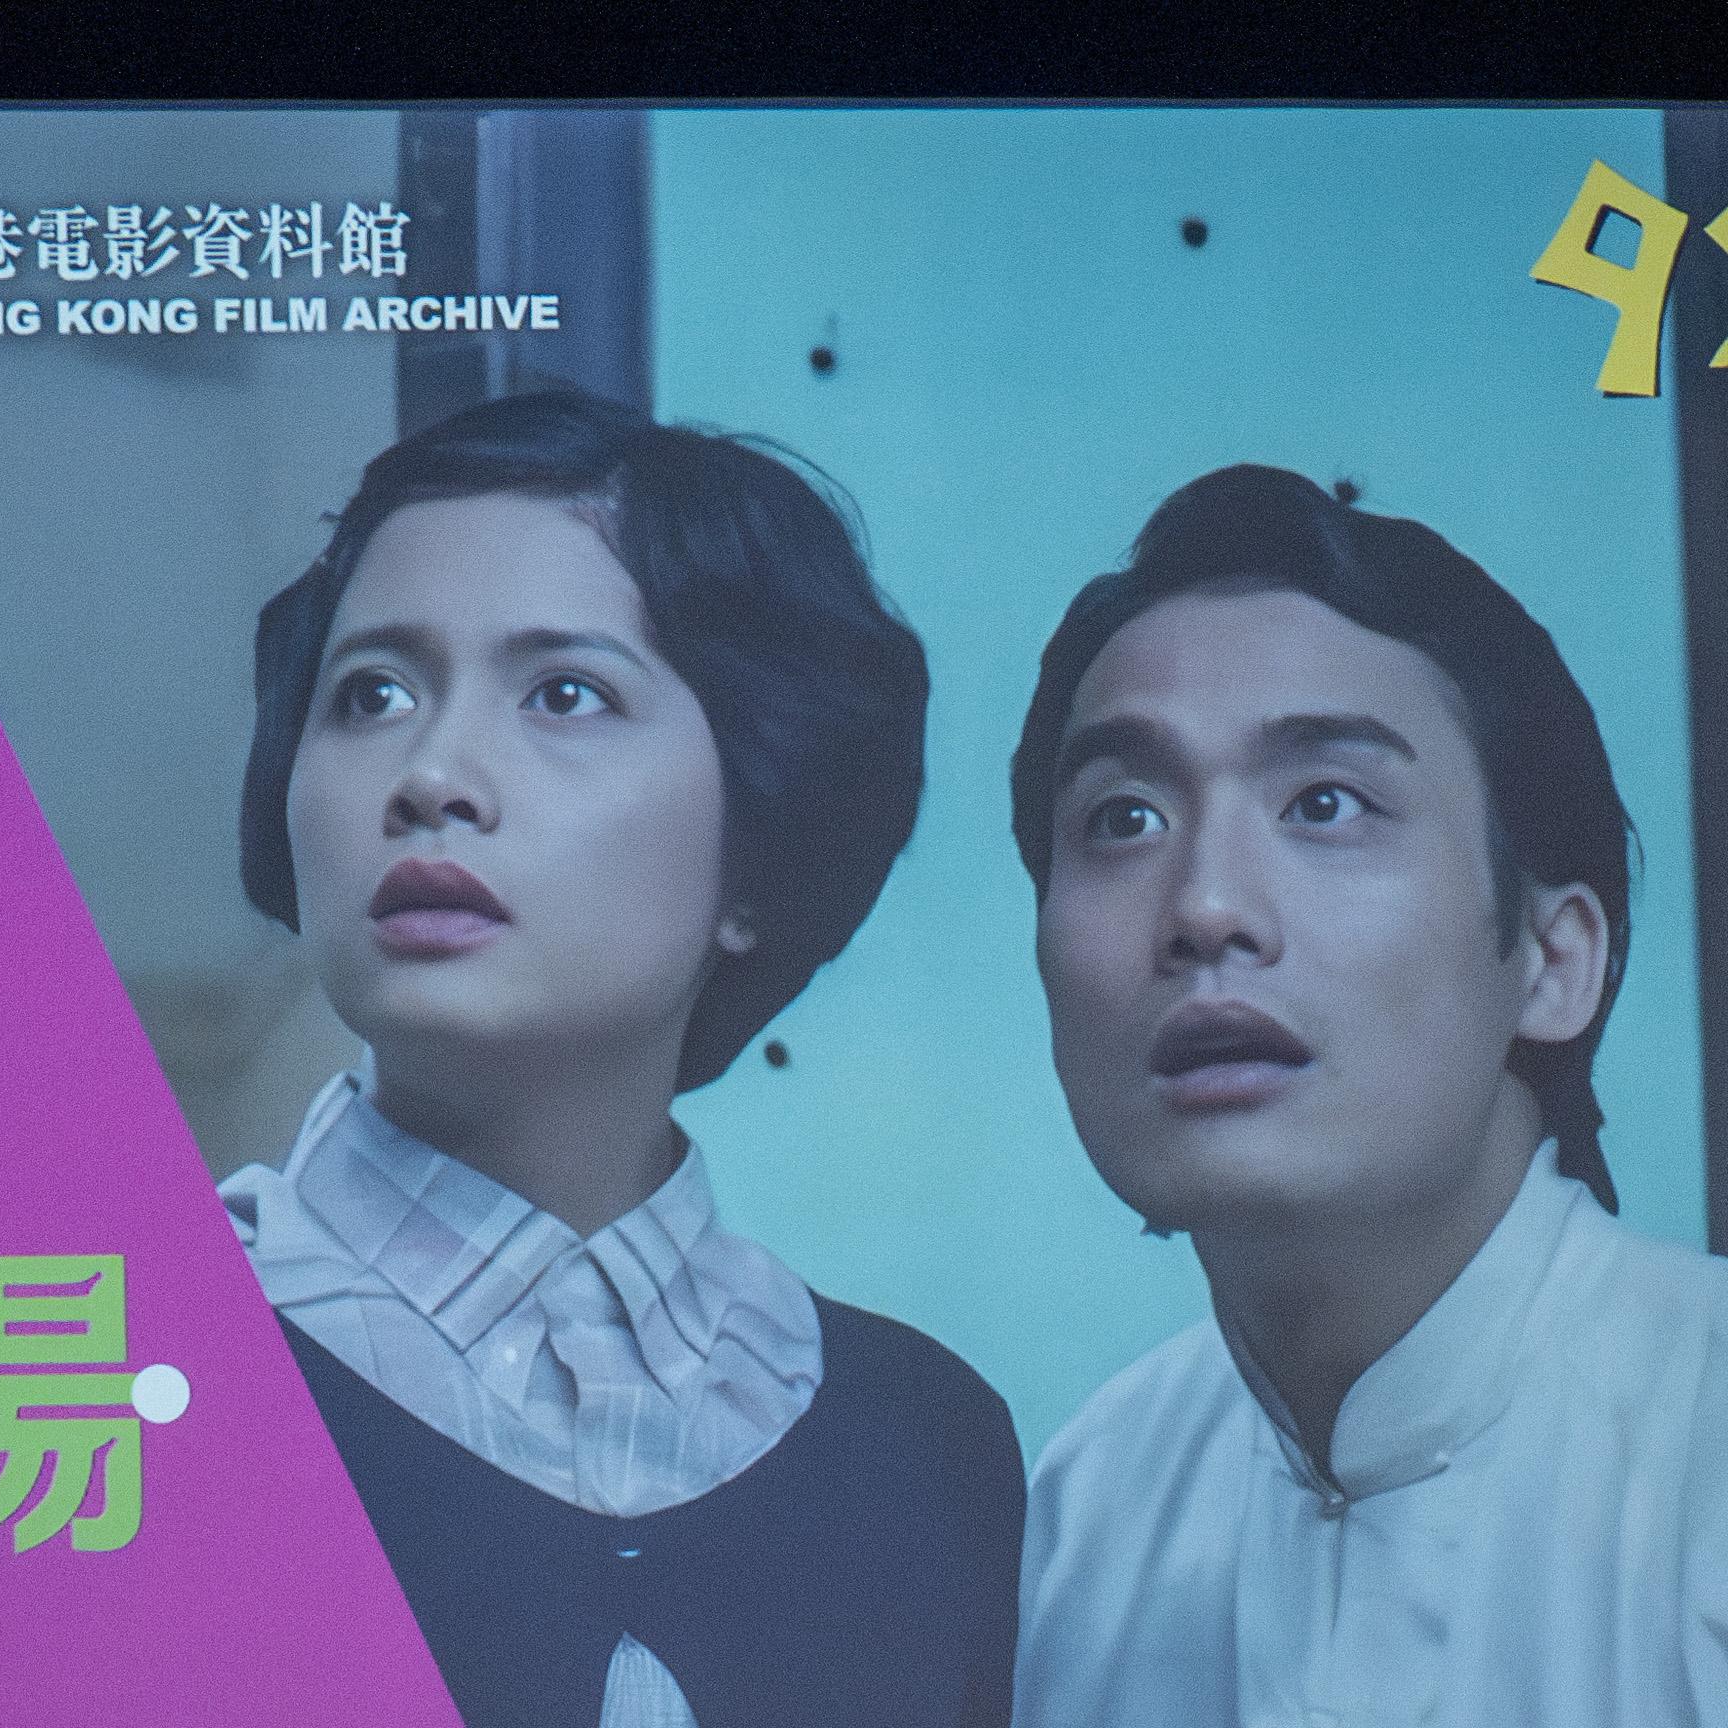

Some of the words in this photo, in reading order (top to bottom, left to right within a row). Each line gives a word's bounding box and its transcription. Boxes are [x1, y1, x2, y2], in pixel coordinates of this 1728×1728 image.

[62, 298, 198, 334] KONG
[214, 297, 328, 333] FILM
[342, 294, 559, 332] ARCHIVE
